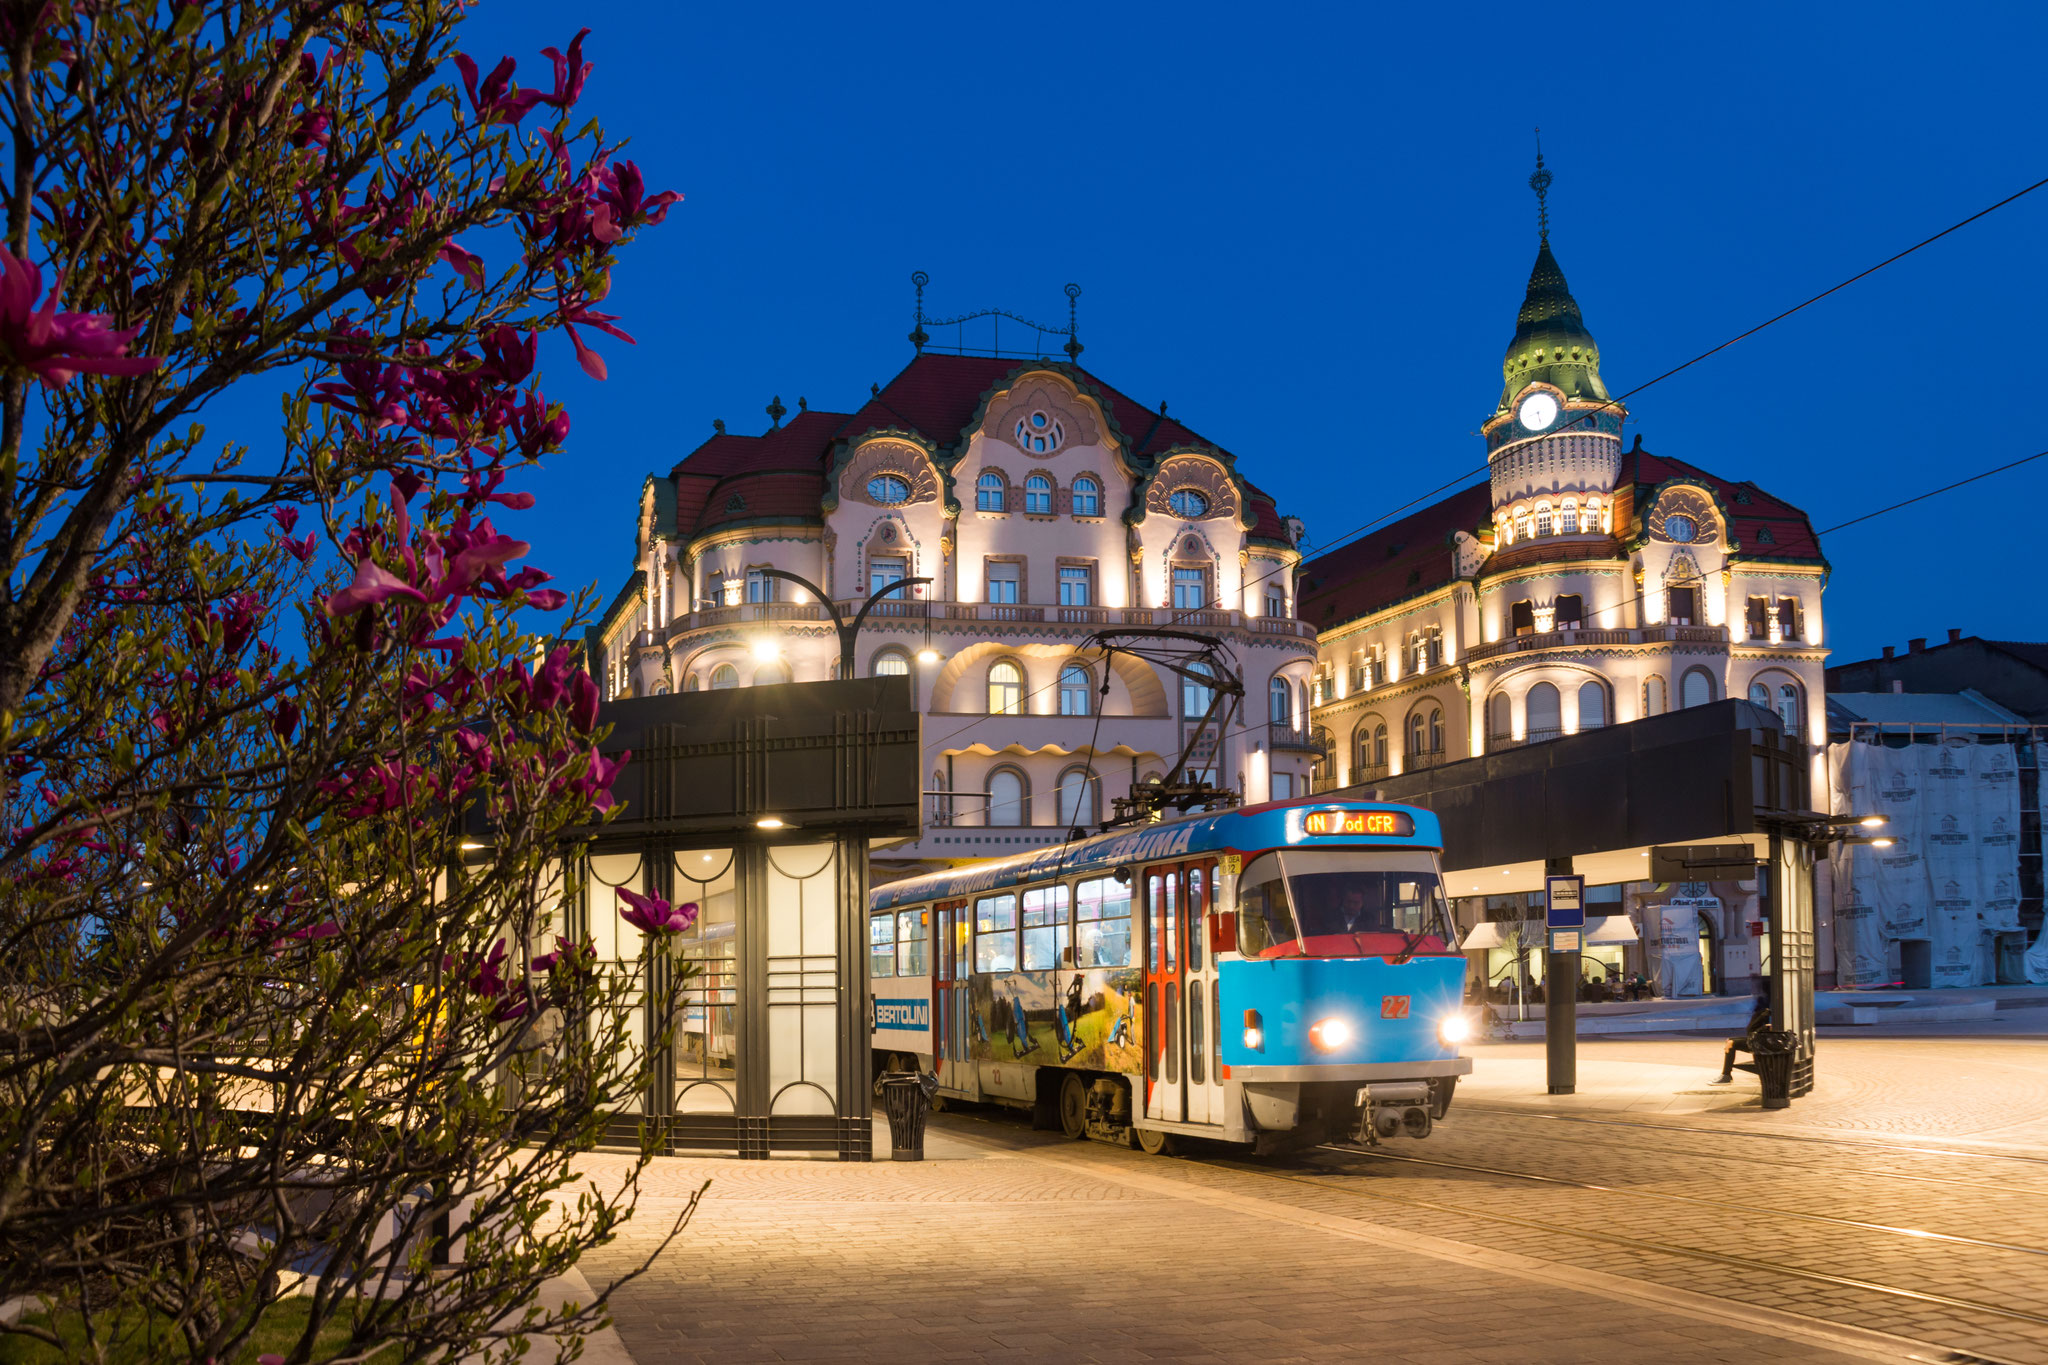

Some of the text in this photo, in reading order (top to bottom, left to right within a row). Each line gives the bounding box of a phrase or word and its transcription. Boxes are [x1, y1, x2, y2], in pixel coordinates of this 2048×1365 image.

[1340, 815, 1363, 832] od
[1367, 815, 1394, 832] CFR
[876, 1005, 928, 1025] BERTOLINI
[1382, 996, 1409, 1018] 22
